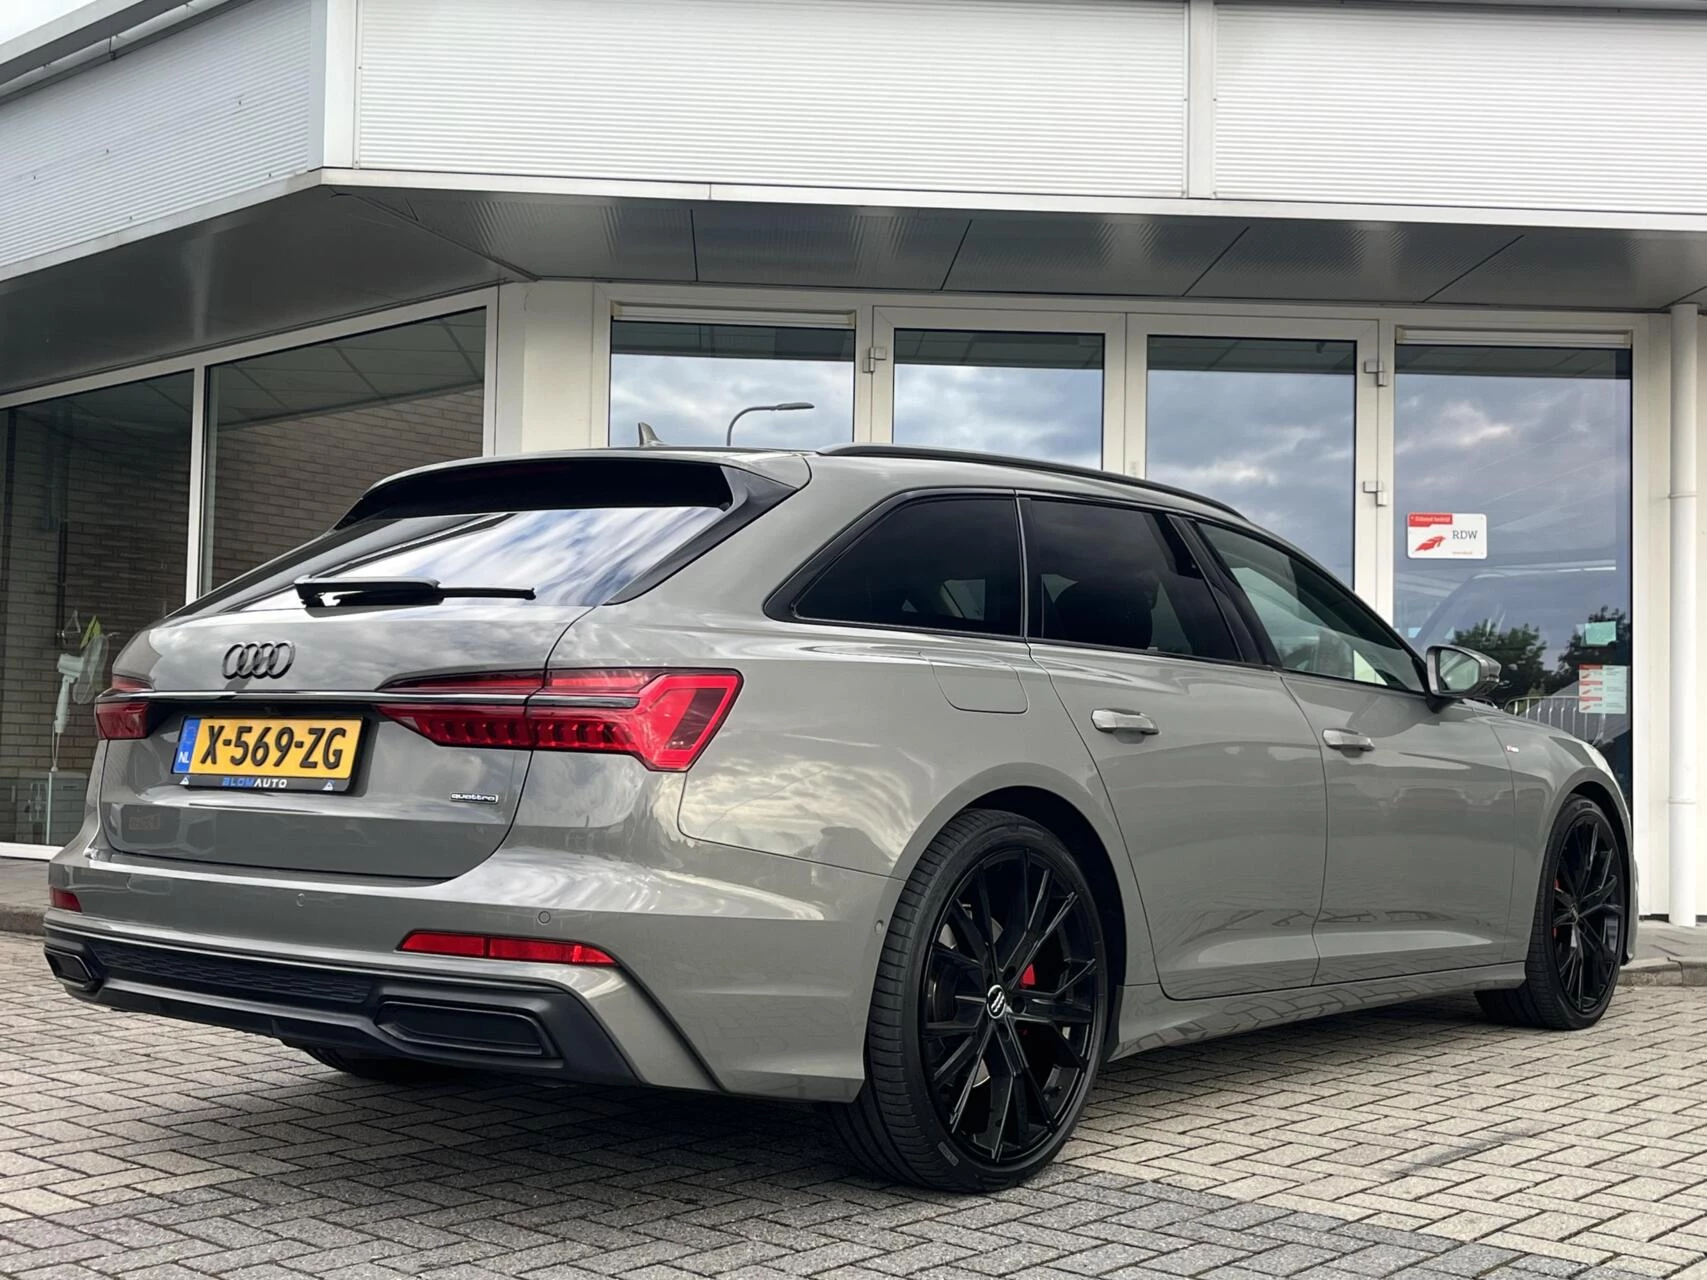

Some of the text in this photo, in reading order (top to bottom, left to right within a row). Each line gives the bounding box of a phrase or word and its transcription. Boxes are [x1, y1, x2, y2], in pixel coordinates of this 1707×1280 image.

[1452, 530, 1478, 539] RDW
[200, 725, 347, 770] X-569-ZG
[178, 751, 190, 764] NL
[451, 793, 496, 801] quattro
